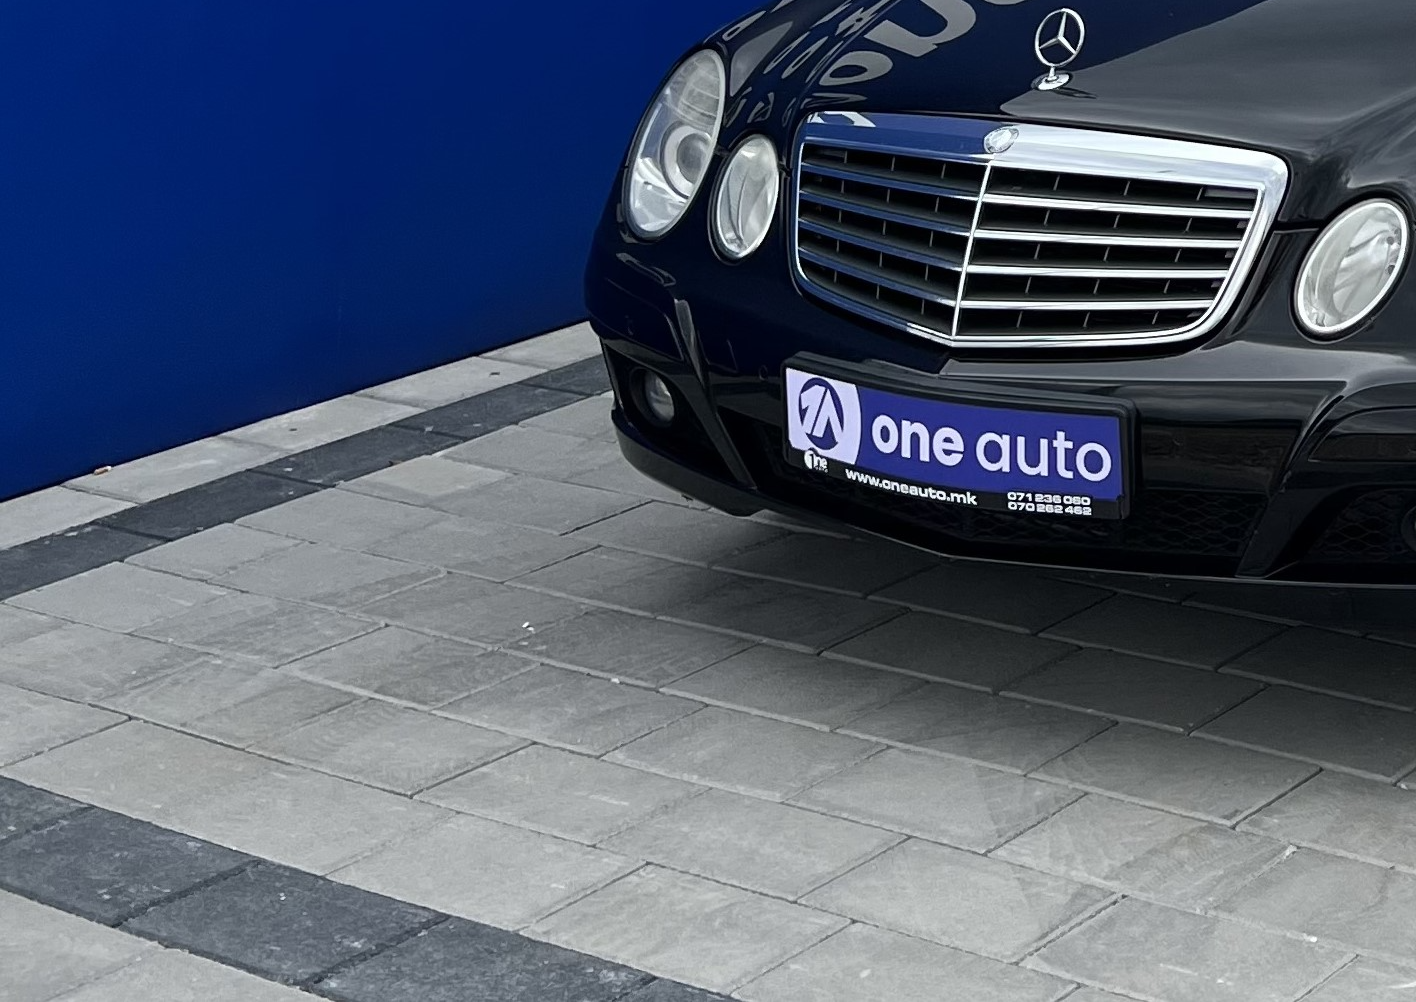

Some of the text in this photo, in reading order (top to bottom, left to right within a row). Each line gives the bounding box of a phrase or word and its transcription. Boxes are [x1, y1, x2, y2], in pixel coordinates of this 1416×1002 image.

[871, 414, 1113, 483] one auto
[845, 468, 978, 506] www.oneauto.mk
[1007, 491, 1033, 502] 071
[1008, 501, 1035, 512] 070
